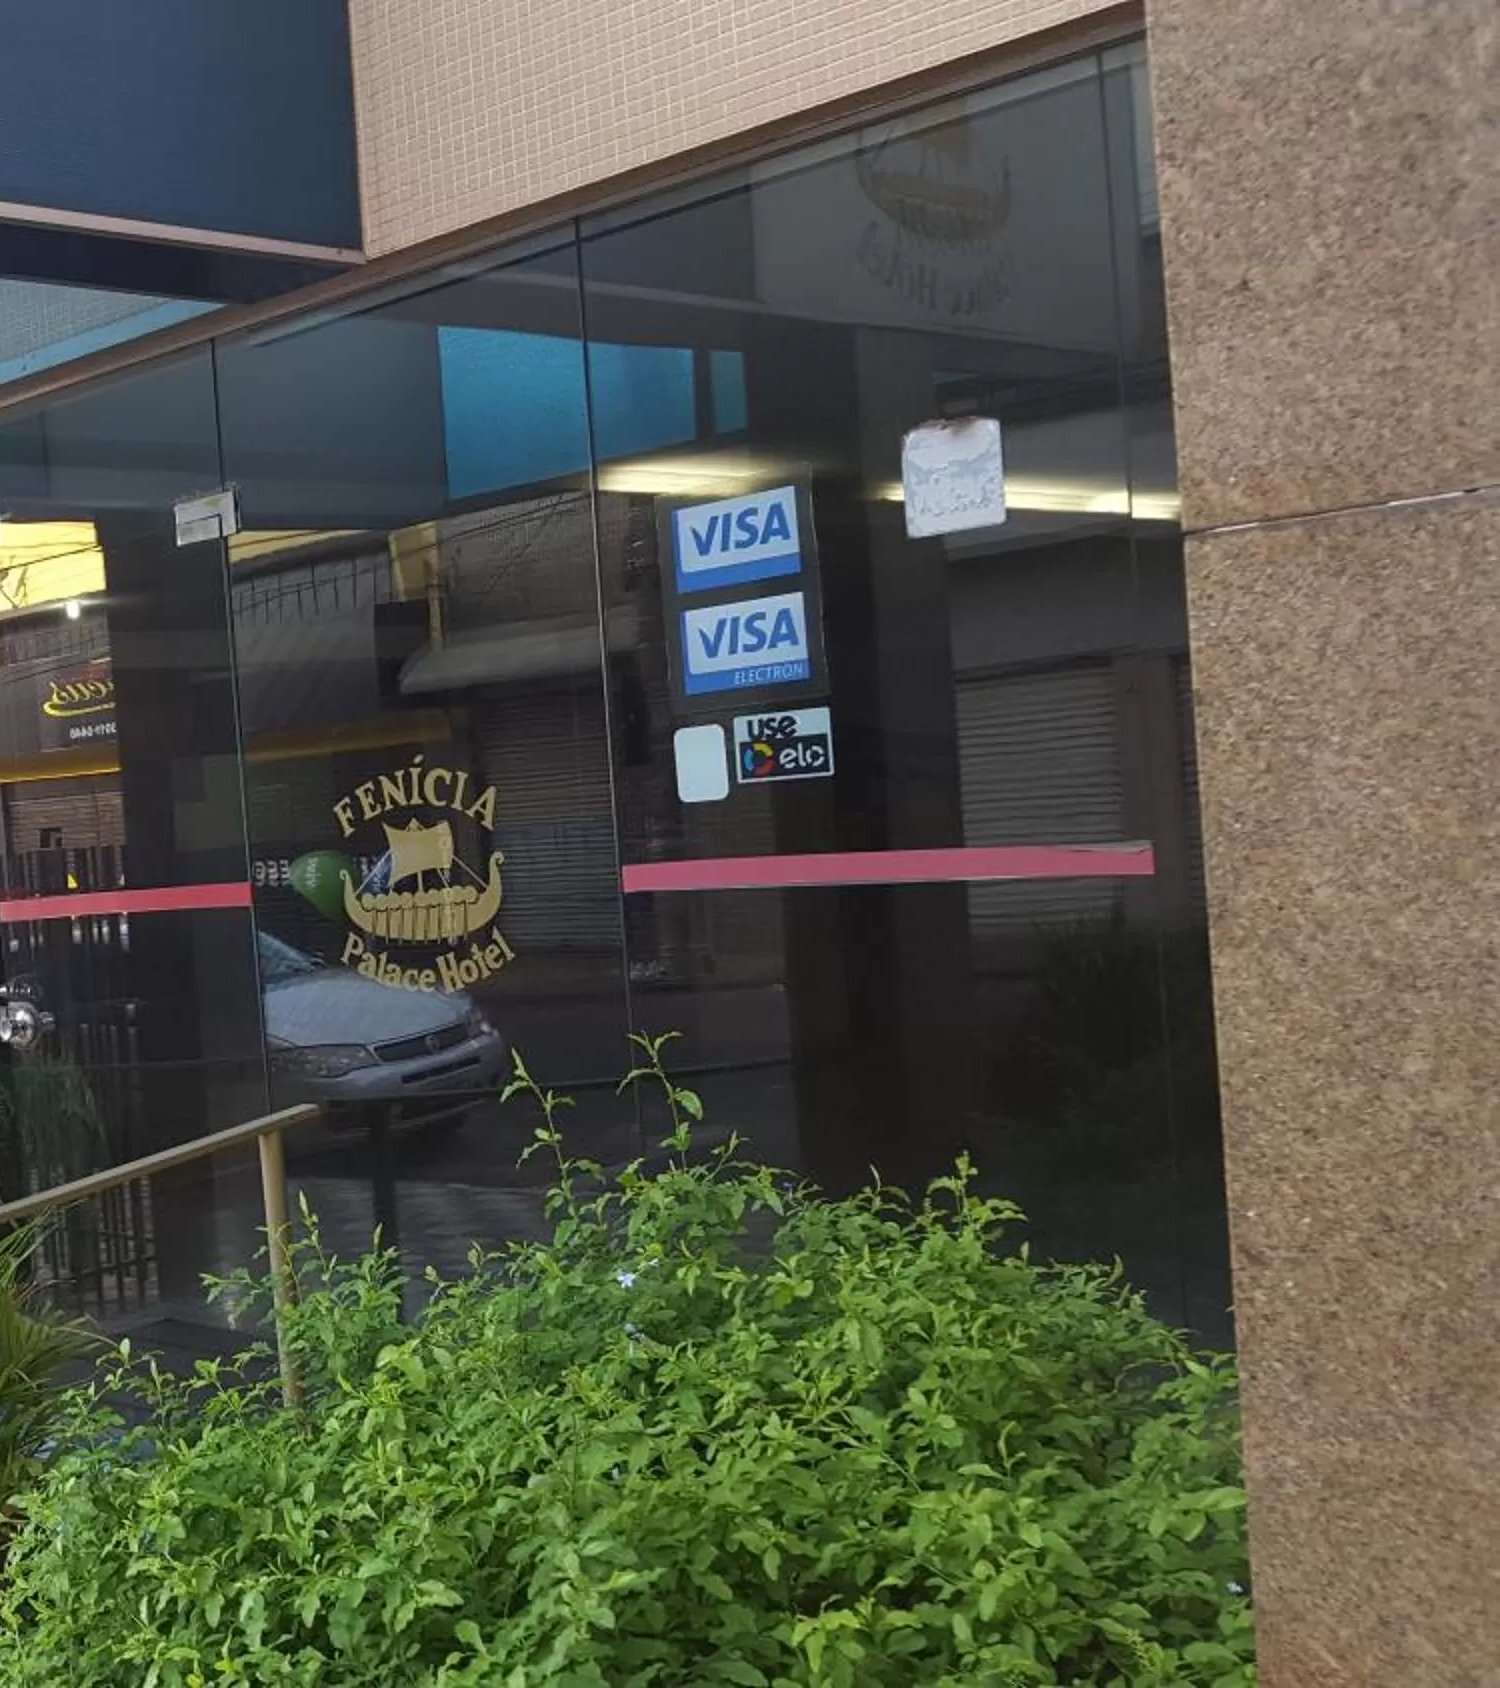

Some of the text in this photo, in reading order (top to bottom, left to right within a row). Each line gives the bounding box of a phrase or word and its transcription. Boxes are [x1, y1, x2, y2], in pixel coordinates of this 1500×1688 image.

[690, 502, 791, 556] VISA
[698, 607, 799, 660] VISA
[734, 662, 803, 685] ELECTRON
[746, 715, 797, 741] use
[778, 743, 825, 770] elo
[332, 754, 498, 838] FENÍCIA
[340, 931, 437, 992] Palace
